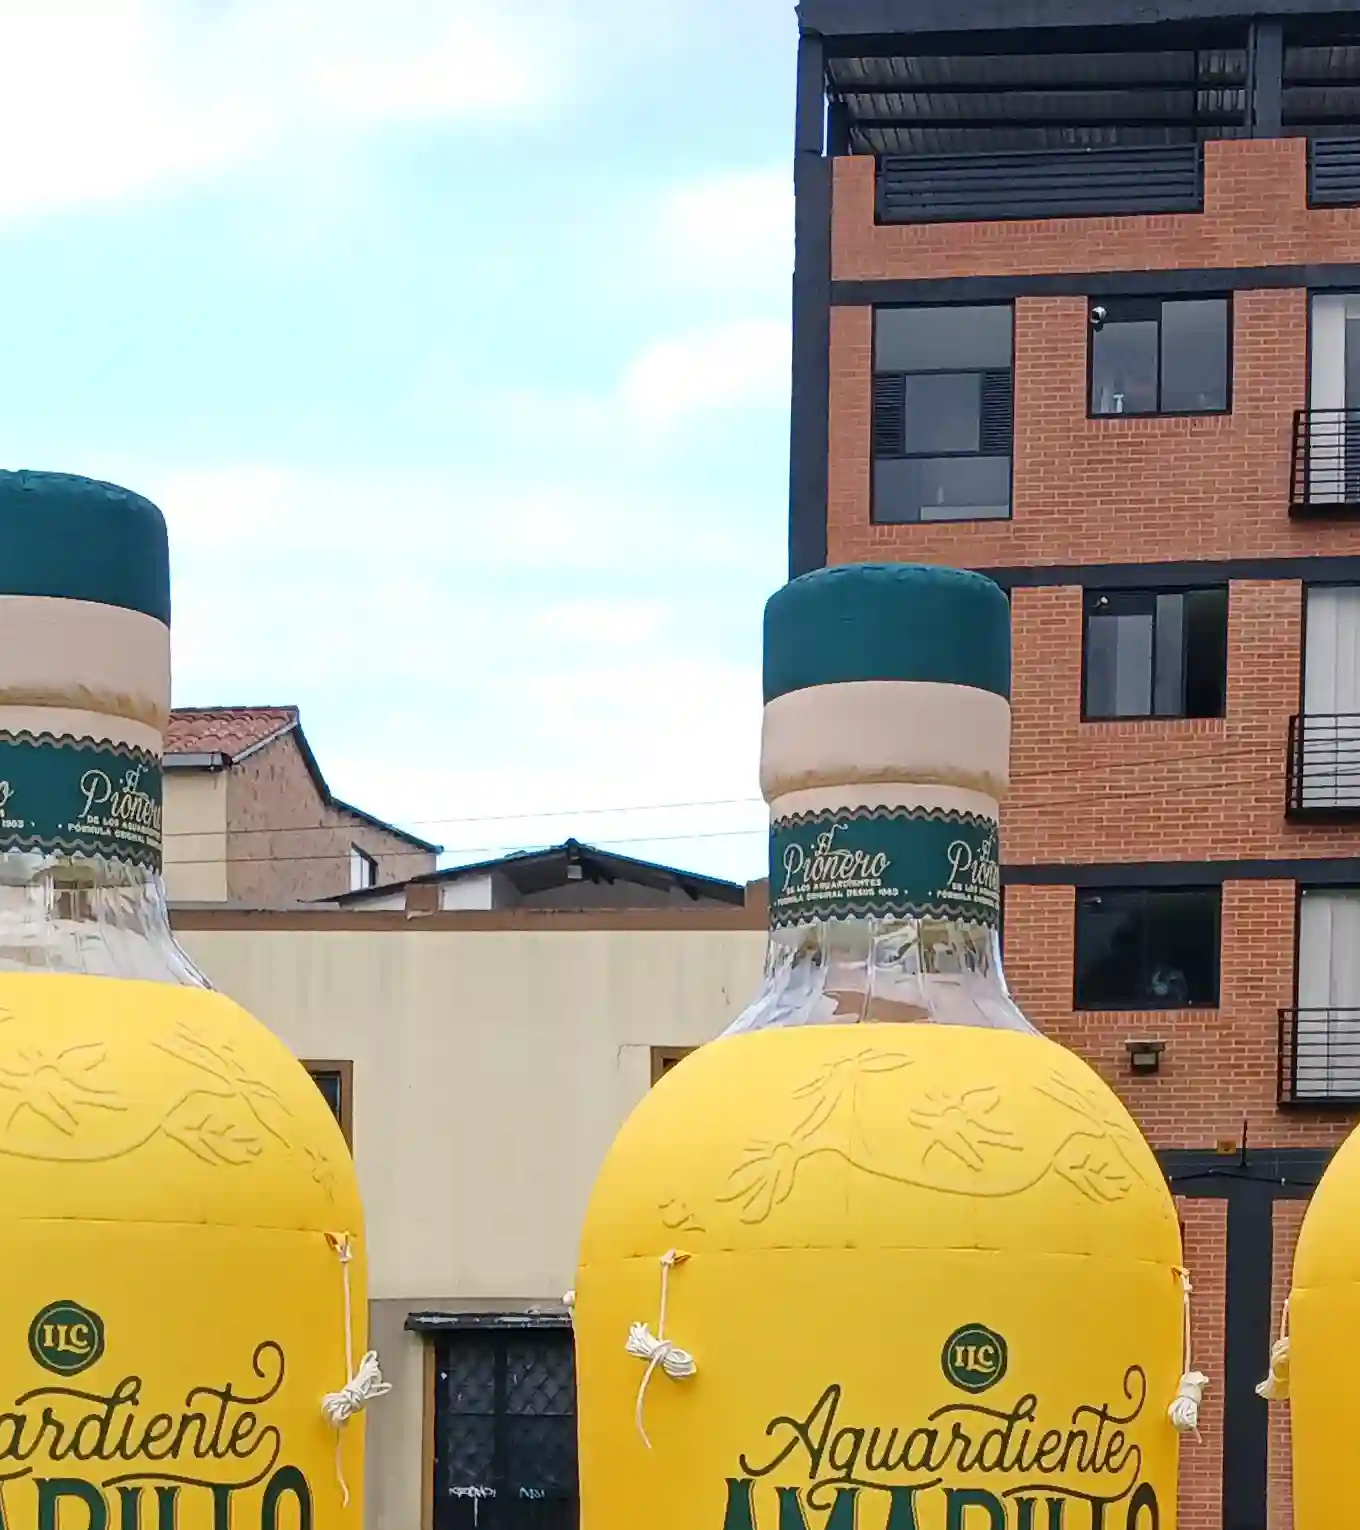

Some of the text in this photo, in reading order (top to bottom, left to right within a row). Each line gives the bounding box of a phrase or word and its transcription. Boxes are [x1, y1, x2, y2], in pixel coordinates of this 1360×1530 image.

[782, 842, 892, 893] Pionero
[43, 1323, 90, 1354] ILC
[953, 1343, 996, 1374] ILC
[740, 1364, 1147, 1511] Aguardiente
